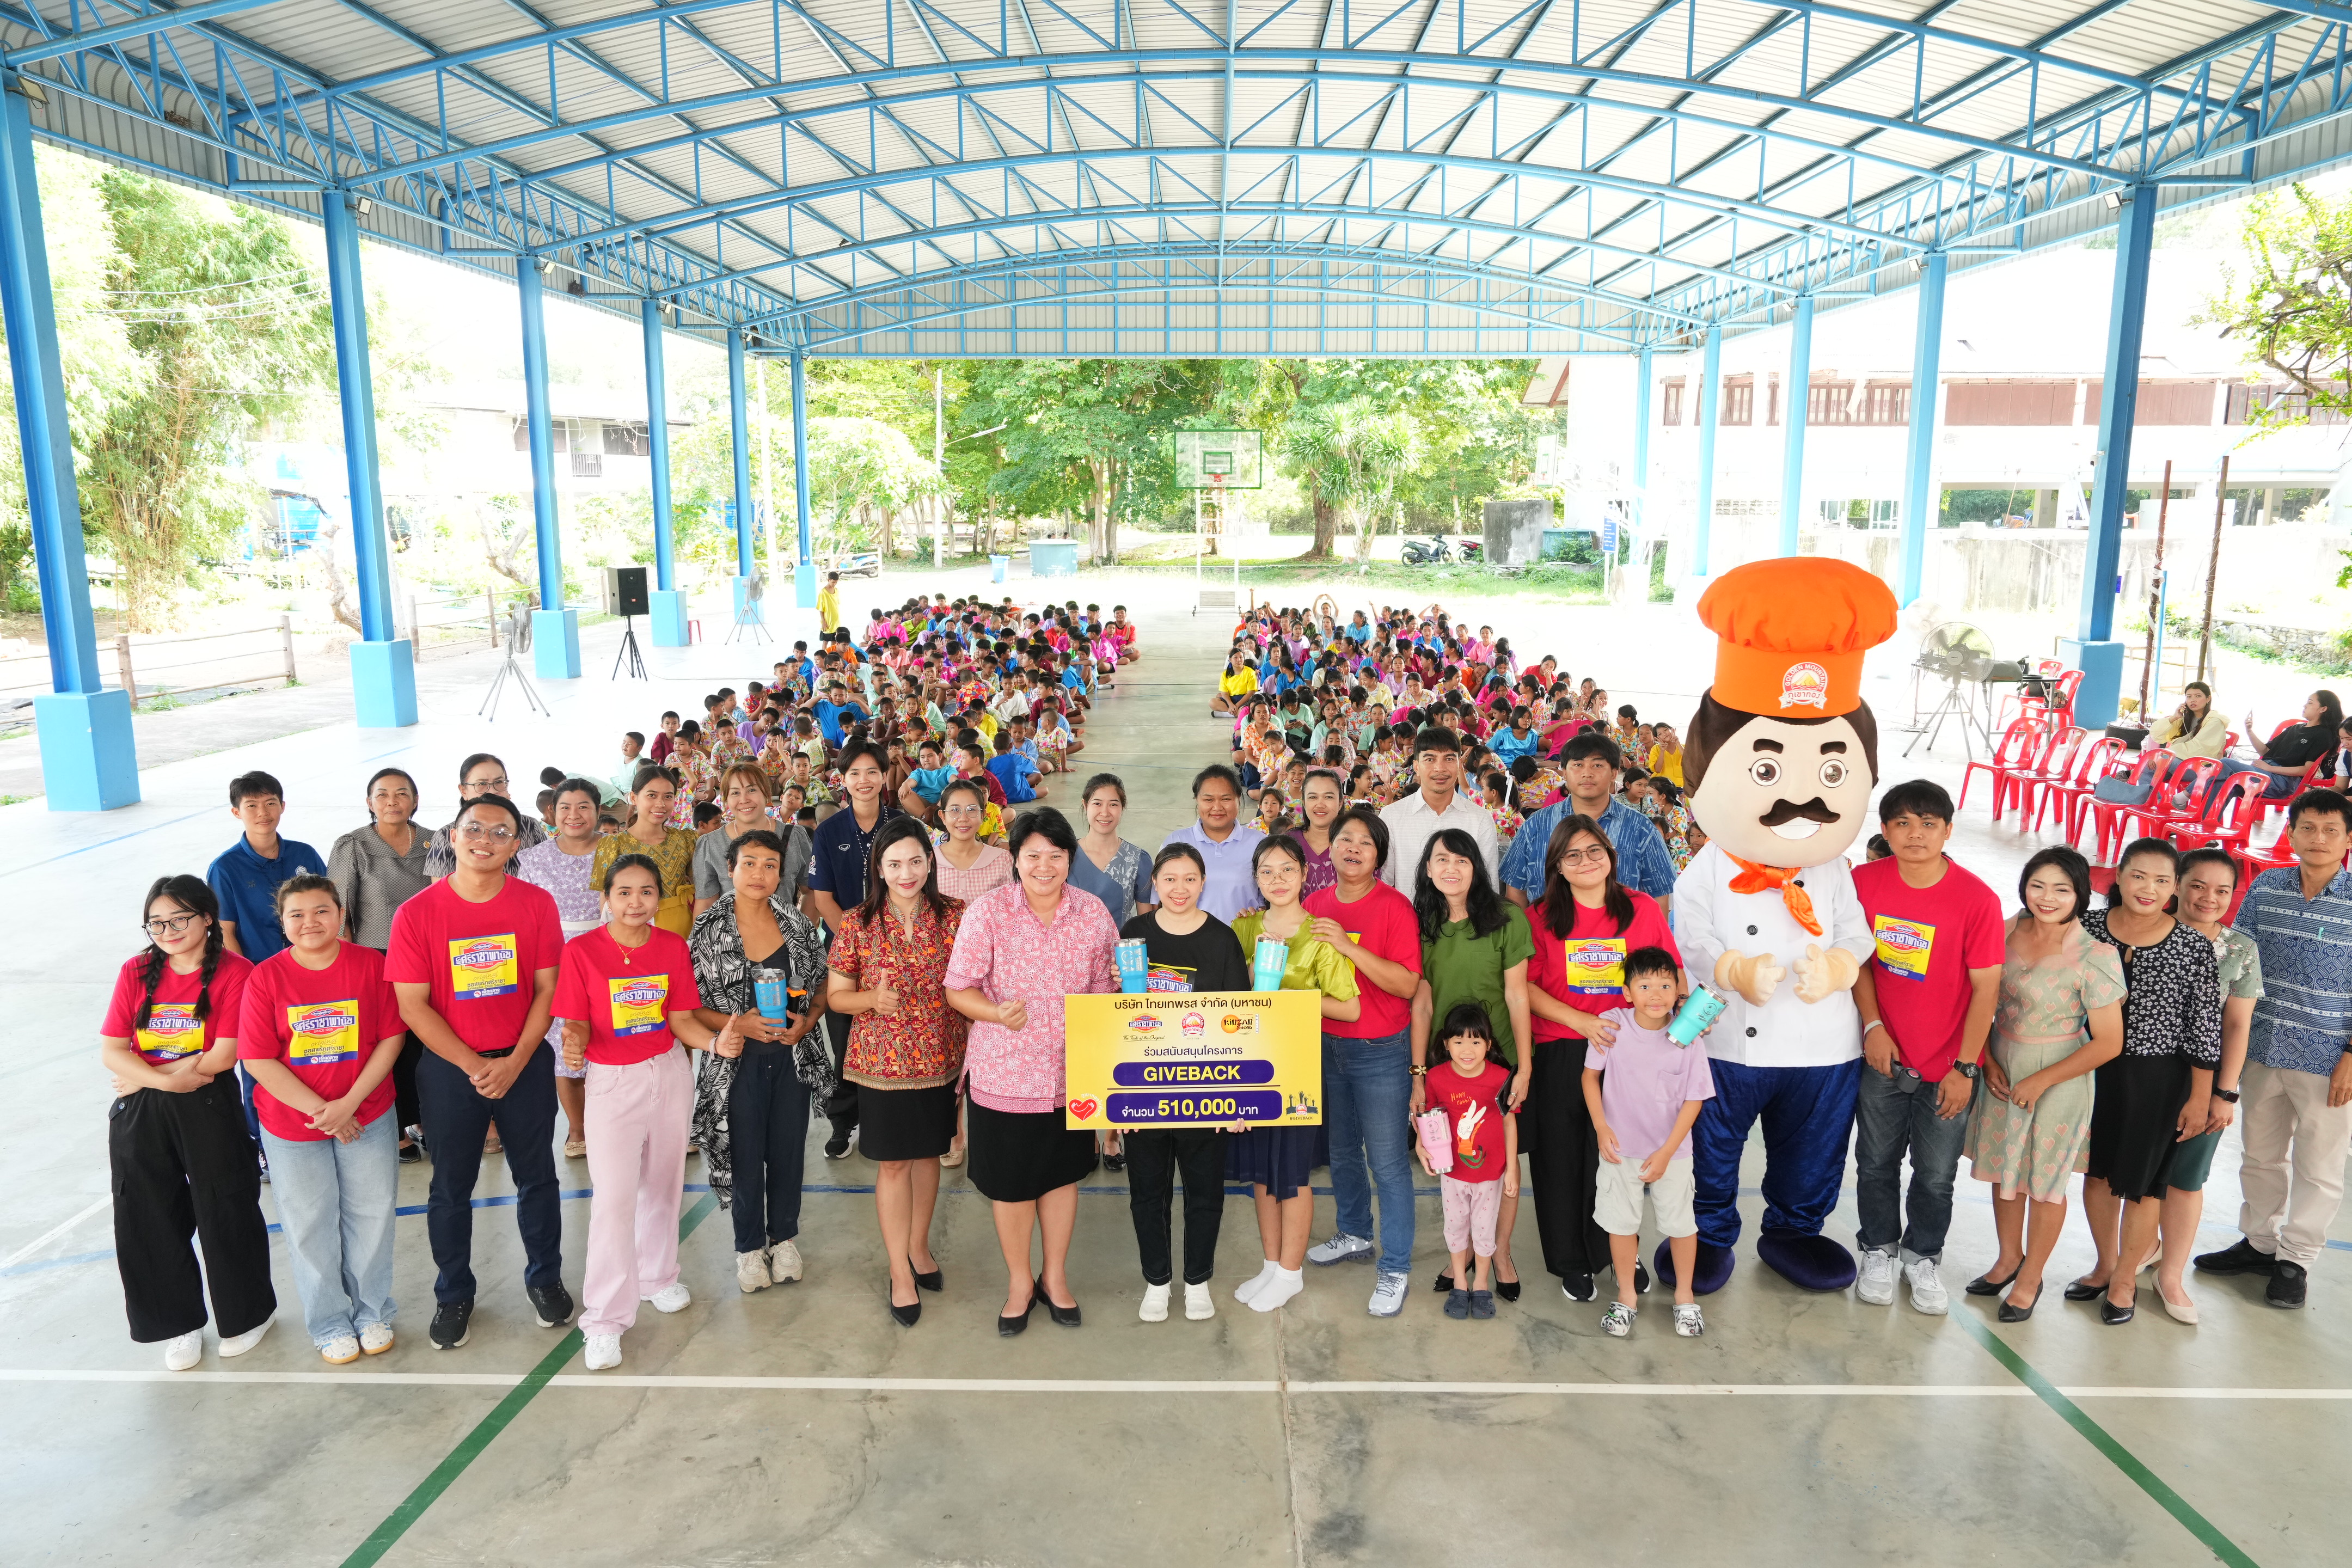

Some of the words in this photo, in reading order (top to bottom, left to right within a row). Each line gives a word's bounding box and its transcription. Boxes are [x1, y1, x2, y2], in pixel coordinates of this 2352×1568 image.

[1785, 665, 1804, 686] GOLDEN
[1804, 664, 1826, 687] MOUNTAIN
[1882, 932, 1927, 948] ศรีราชาพานิช
[461, 951, 511, 964] ศรีราชาพานิช
[1575, 952, 1622, 961] ศรีราชาพานิช
[473, 971, 498, 981] original
[467, 978, 505, 987] ซอสพริกศรีราชา
[620, 990, 665, 1001] ศรีราชาพานิช
[1114, 999, 1143, 1009] บริษัท
[1145, 998, 1197, 1009] ไทยเทพรส
[1200, 997, 1228, 1008] จำกัด
[1231, 997, 1272, 1009] (มหาชน)
[299, 1017, 353, 1031] ศรีราชาพานิช
[311, 1038, 338, 1046] original
[1144, 1045, 1243, 1058] ร่วมสนับสนุนโครงการ
[1144, 1065, 1241, 1081] GIVEBACK
[1450, 1091, 1465, 1102] Happy
[1456, 1096, 1473, 1105] rabbit
[1122, 1106, 1154, 1117] จำนวน
[1157, 1098, 1236, 1118] 510,000
[1239, 1106, 1258, 1114] บาท
